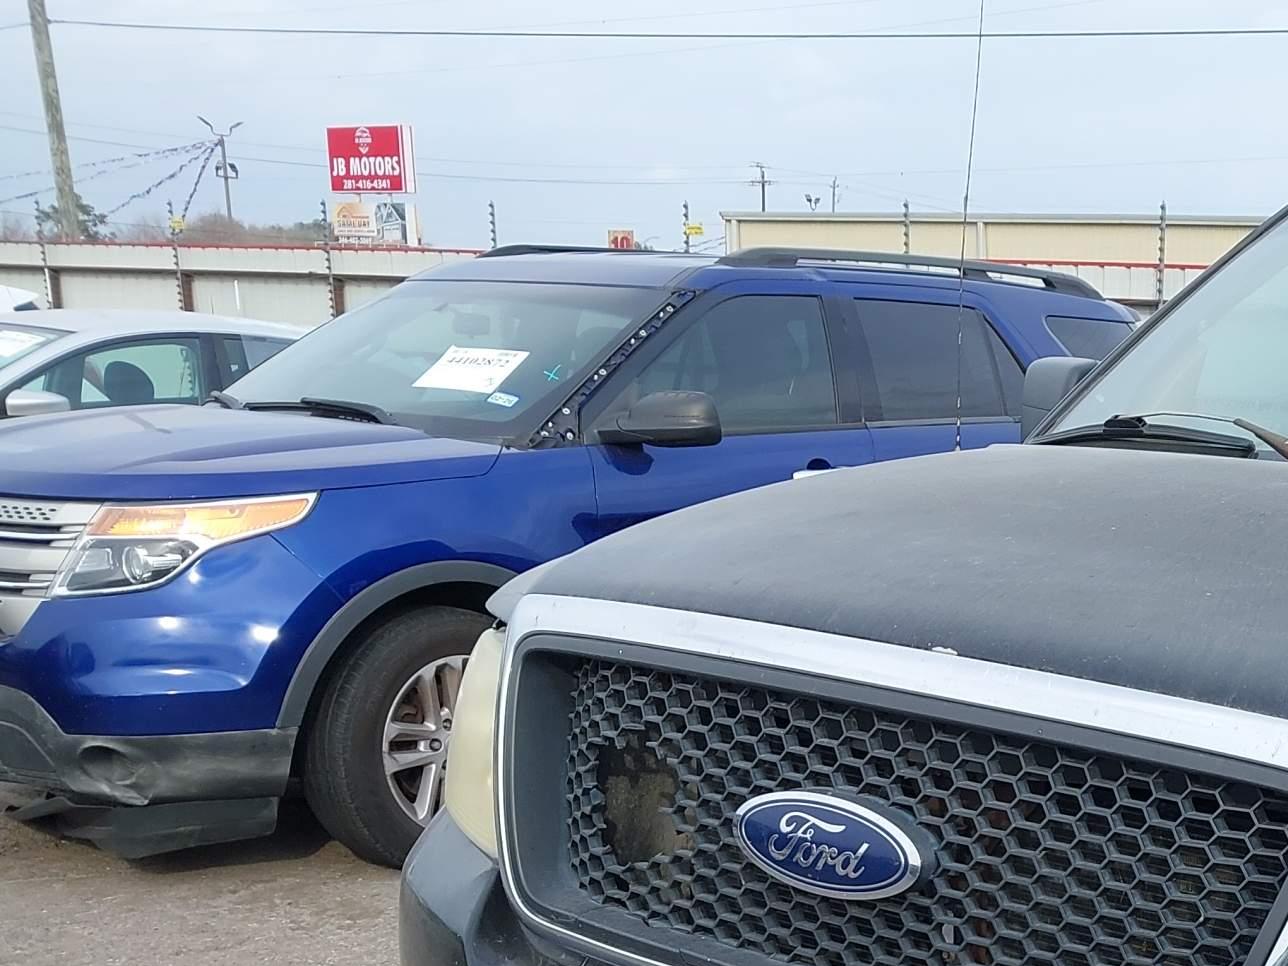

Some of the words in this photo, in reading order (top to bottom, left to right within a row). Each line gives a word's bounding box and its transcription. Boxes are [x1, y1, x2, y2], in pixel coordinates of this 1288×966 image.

[332, 157, 347, 177] JB
[349, 156, 400, 177] MOTORS
[343, 179, 391, 190] 281-416-4341
[767, 811, 870, 879] Ford
